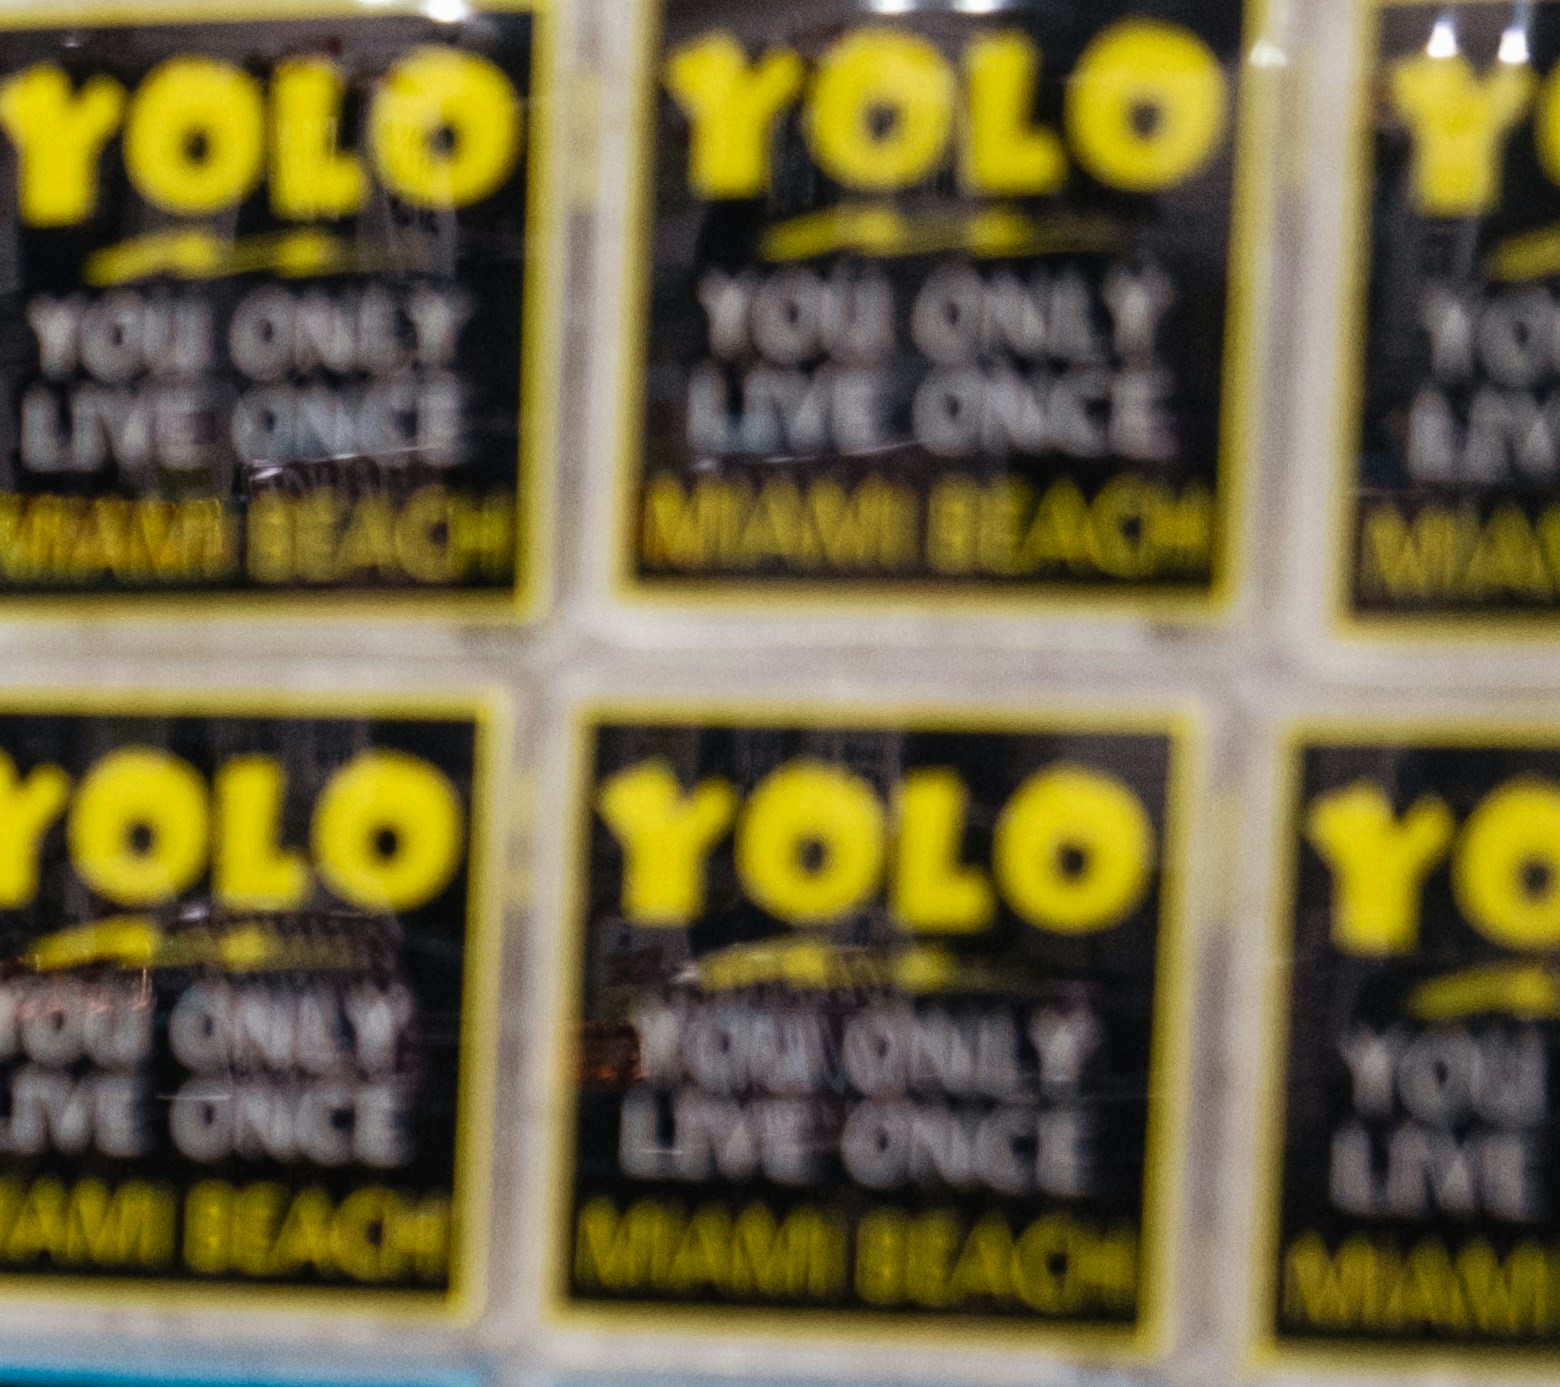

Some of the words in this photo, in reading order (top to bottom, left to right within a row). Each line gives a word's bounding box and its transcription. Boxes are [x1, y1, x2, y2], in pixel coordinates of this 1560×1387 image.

[666, 20, 1227, 201] YOLO
[24, 292, 212, 382] YOU
[231, 290, 473, 381] ONLY
[697, 272, 894, 363] YOU
[913, 266, 1177, 363] ONLY
[21, 381, 214, 470] LIVE
[233, 377, 464, 469] ONCE
[687, 370, 891, 459] LIVE
[913, 367, 1169, 459] ONCE
[248, 498, 508, 582] BEACH
[644, 479, 908, 571] MIAMI
[928, 479, 1209, 576] BEACH
[600, 761, 1152, 935] YOLO
[171, 986, 415, 1077] ONLY
[629, 1006, 823, 1096] YOU
[842, 1012, 1101, 1107] ONLY
[171, 1076, 407, 1167] ONCE
[619, 1096, 823, 1183] LIVE
[842, 1104, 1095, 1196] ONCE
[184, 1186, 452, 1278] BEACH
[576, 1199, 829, 1294] MIAMI
[856, 1210, 1139, 1311] BEACH
